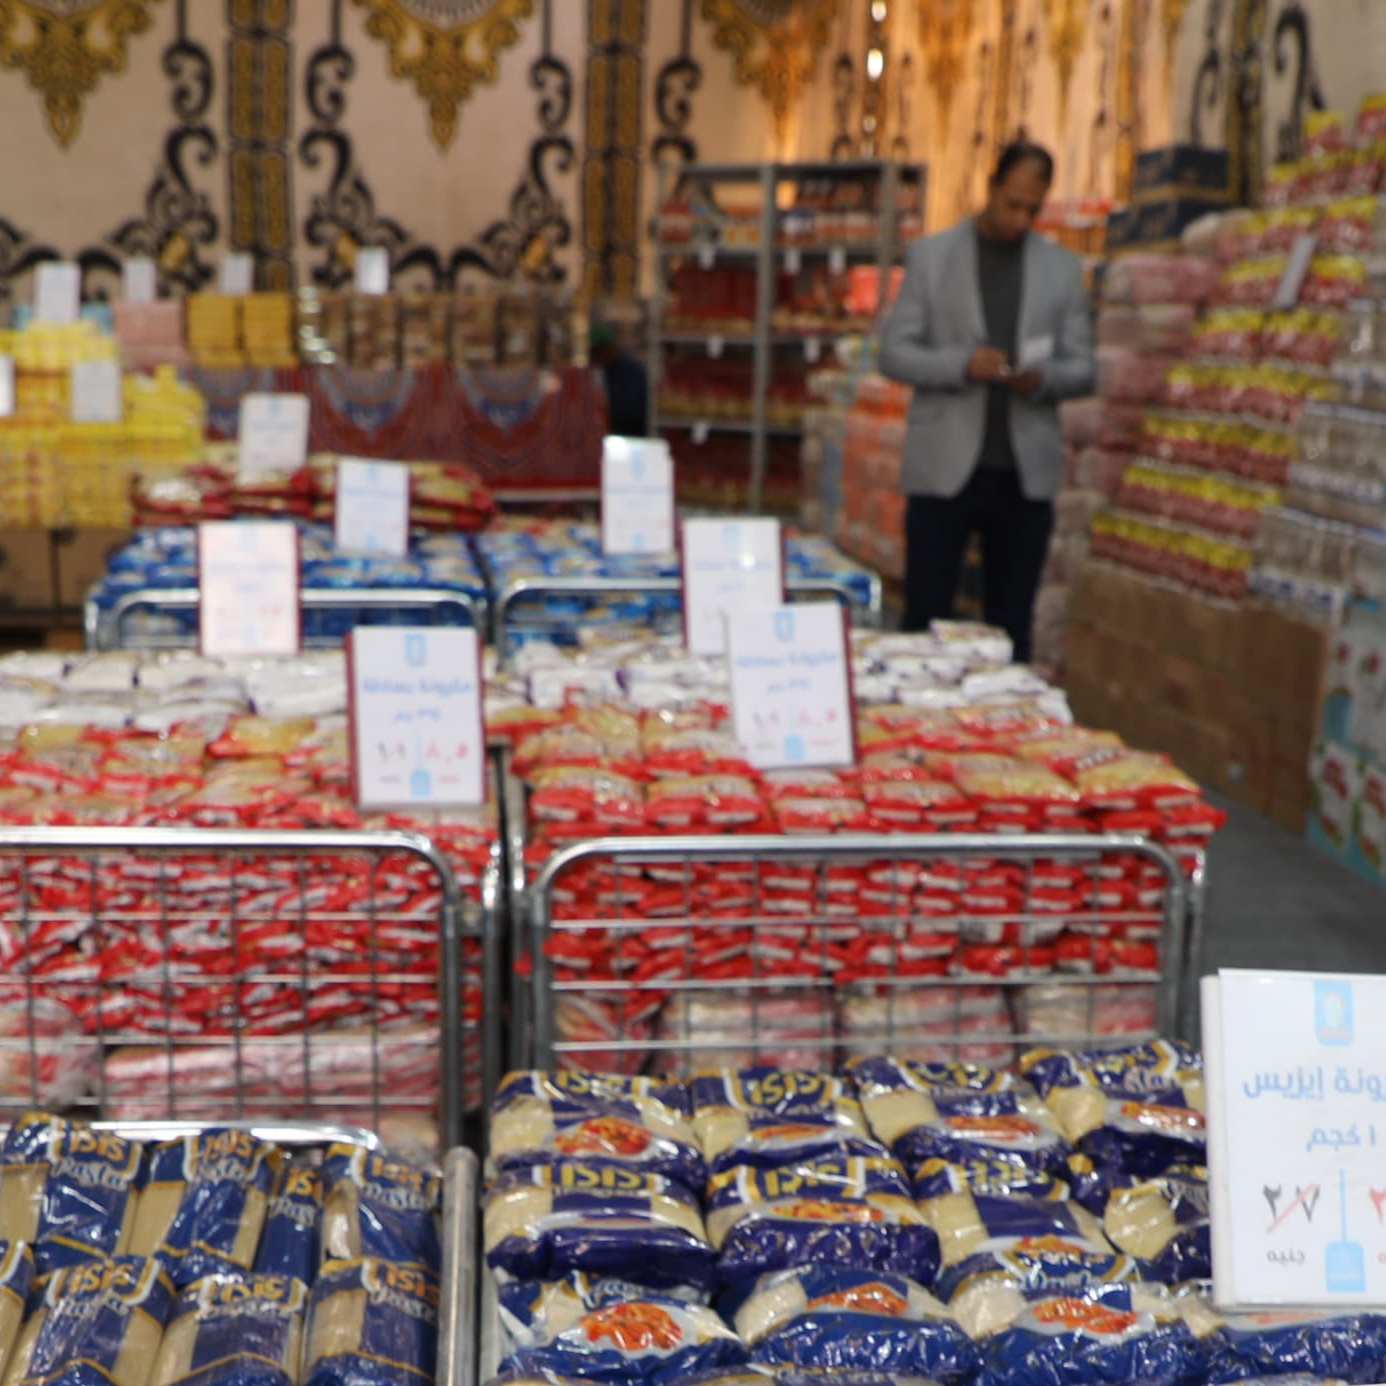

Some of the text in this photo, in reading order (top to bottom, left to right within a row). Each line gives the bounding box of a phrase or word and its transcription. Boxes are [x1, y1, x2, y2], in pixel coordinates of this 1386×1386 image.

[1243, 1066, 1324, 1099] إيزيس
[1307, 1123, 1360, 1152] كجم
[1267, 1248, 1304, 1263] جنيه
